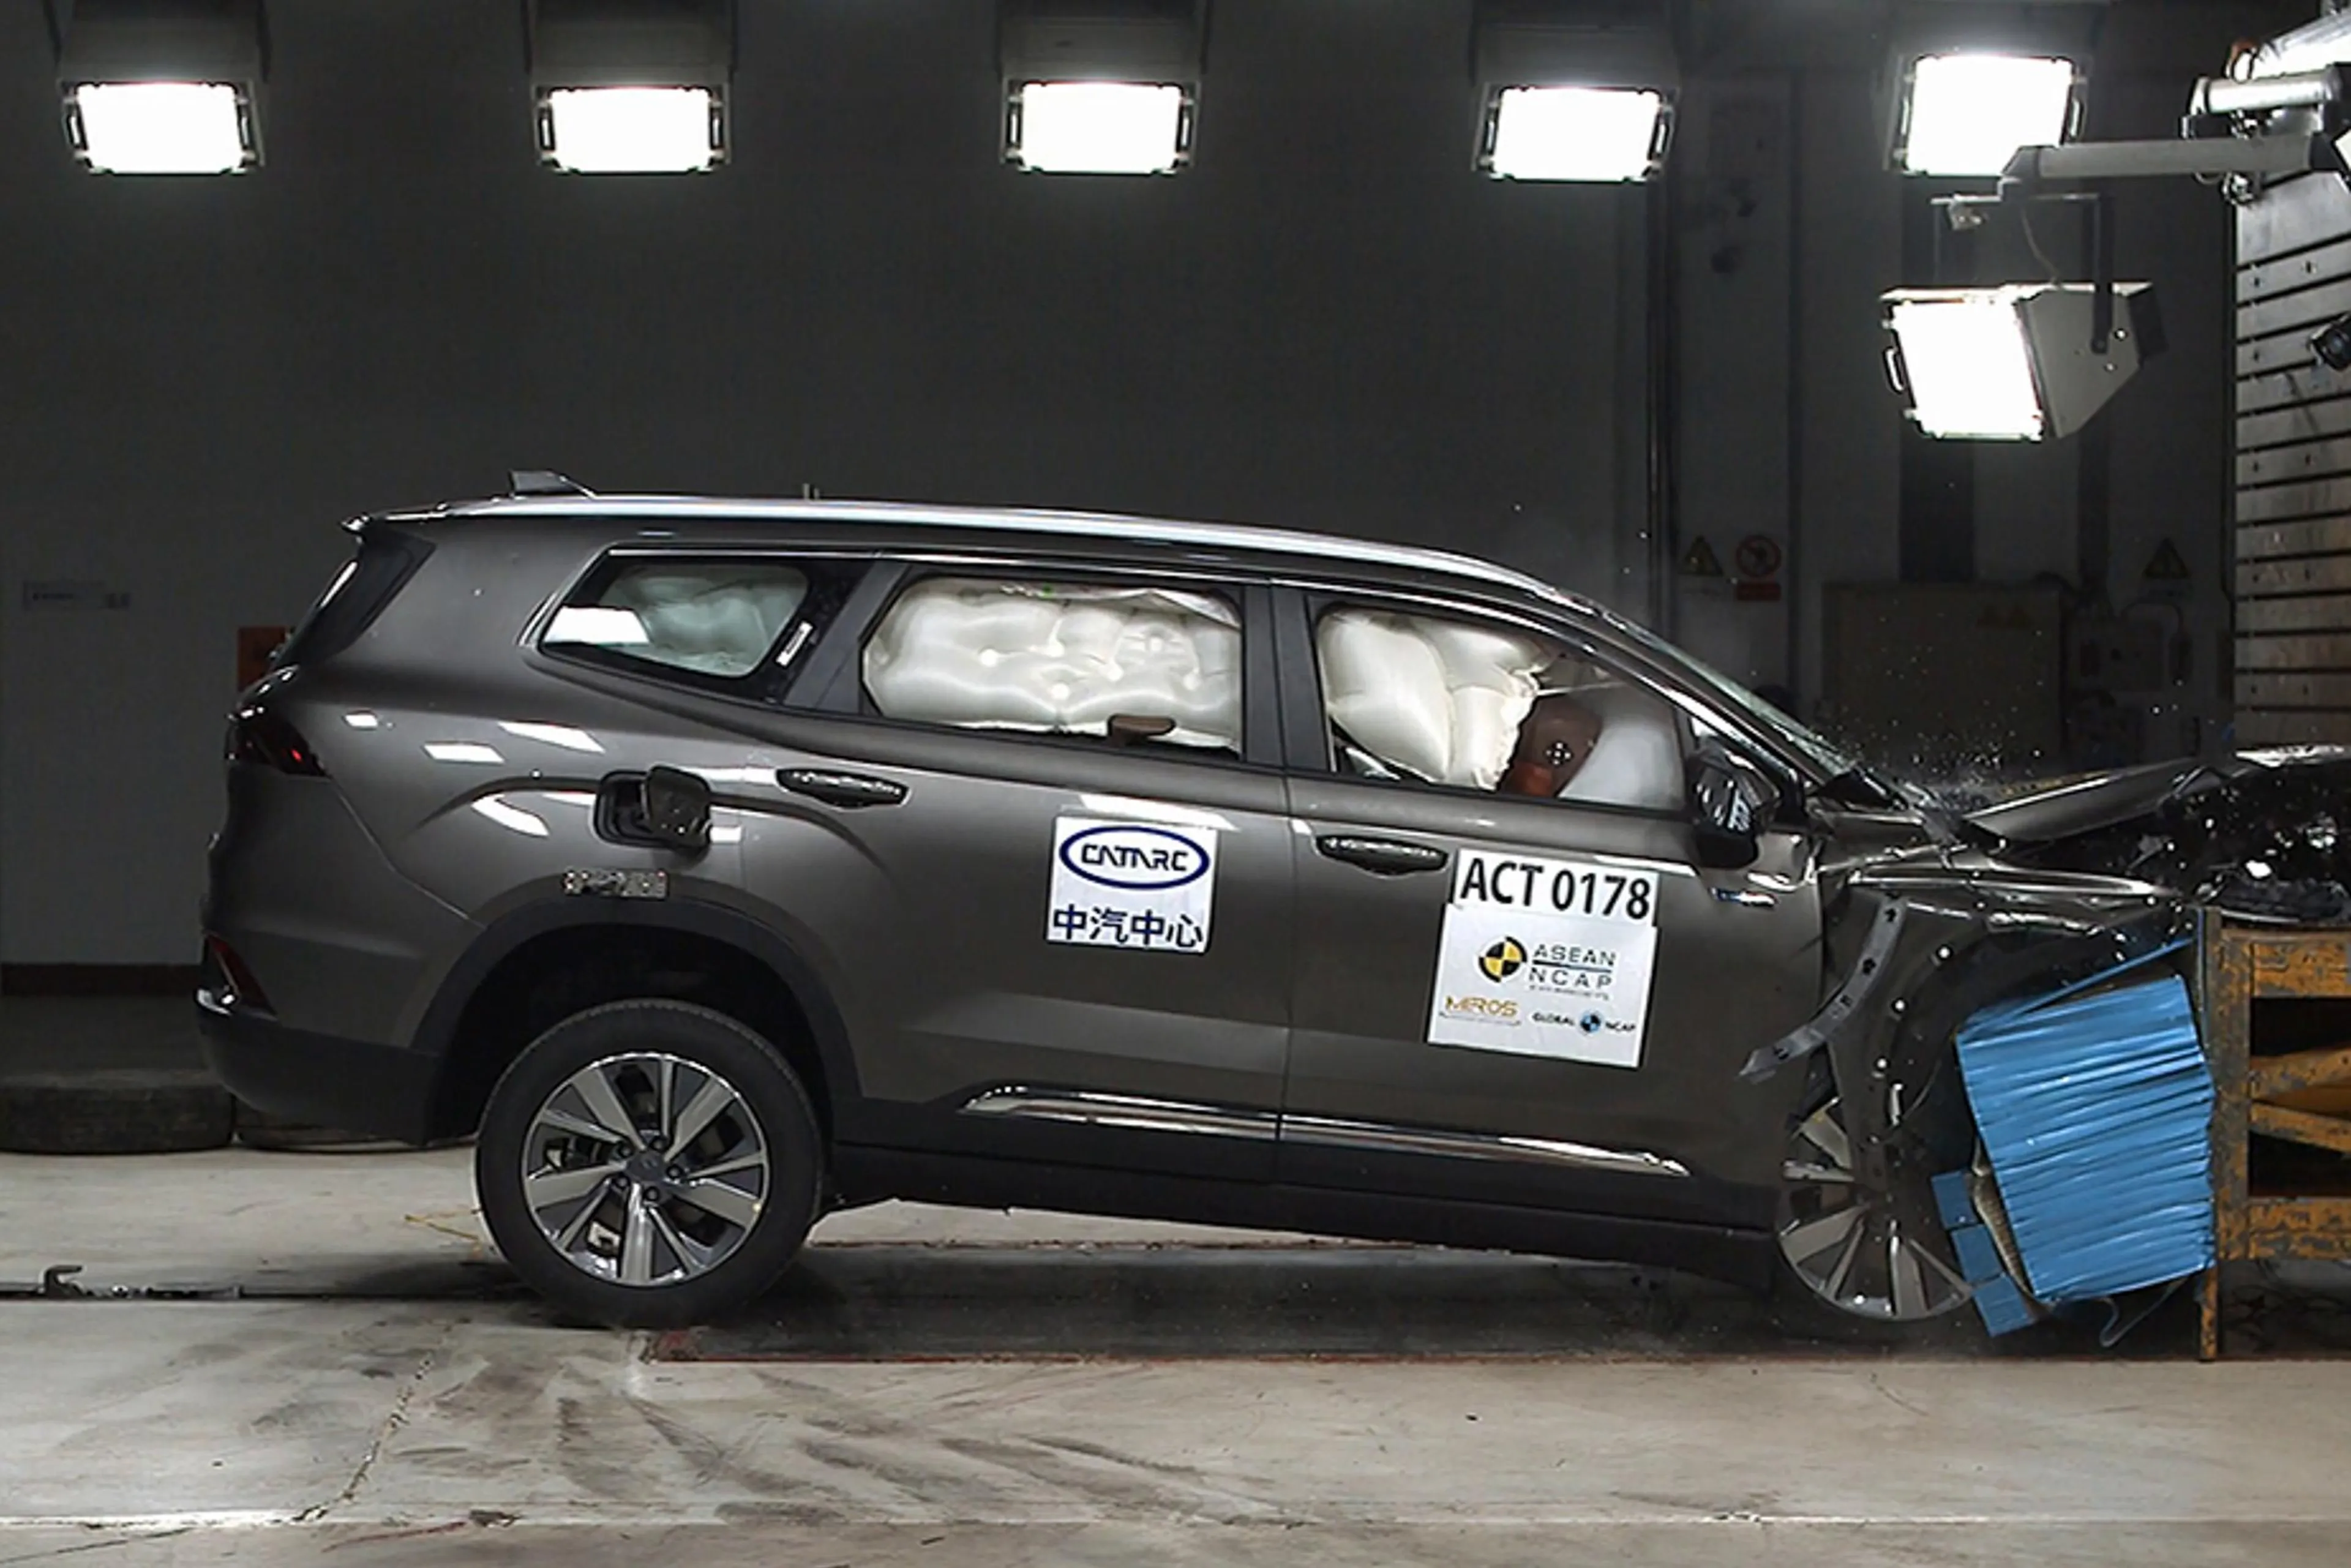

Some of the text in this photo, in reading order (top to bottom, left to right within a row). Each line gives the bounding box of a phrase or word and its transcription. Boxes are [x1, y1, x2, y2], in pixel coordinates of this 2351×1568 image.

[1081, 843, 1188, 871] CATARC
[1460, 858, 1651, 920] ACT 0178
[1053, 903, 1204, 948] 中汽中心
[1534, 943, 1616, 967] ASEAN
[1529, 967, 1613, 990] NCAP
